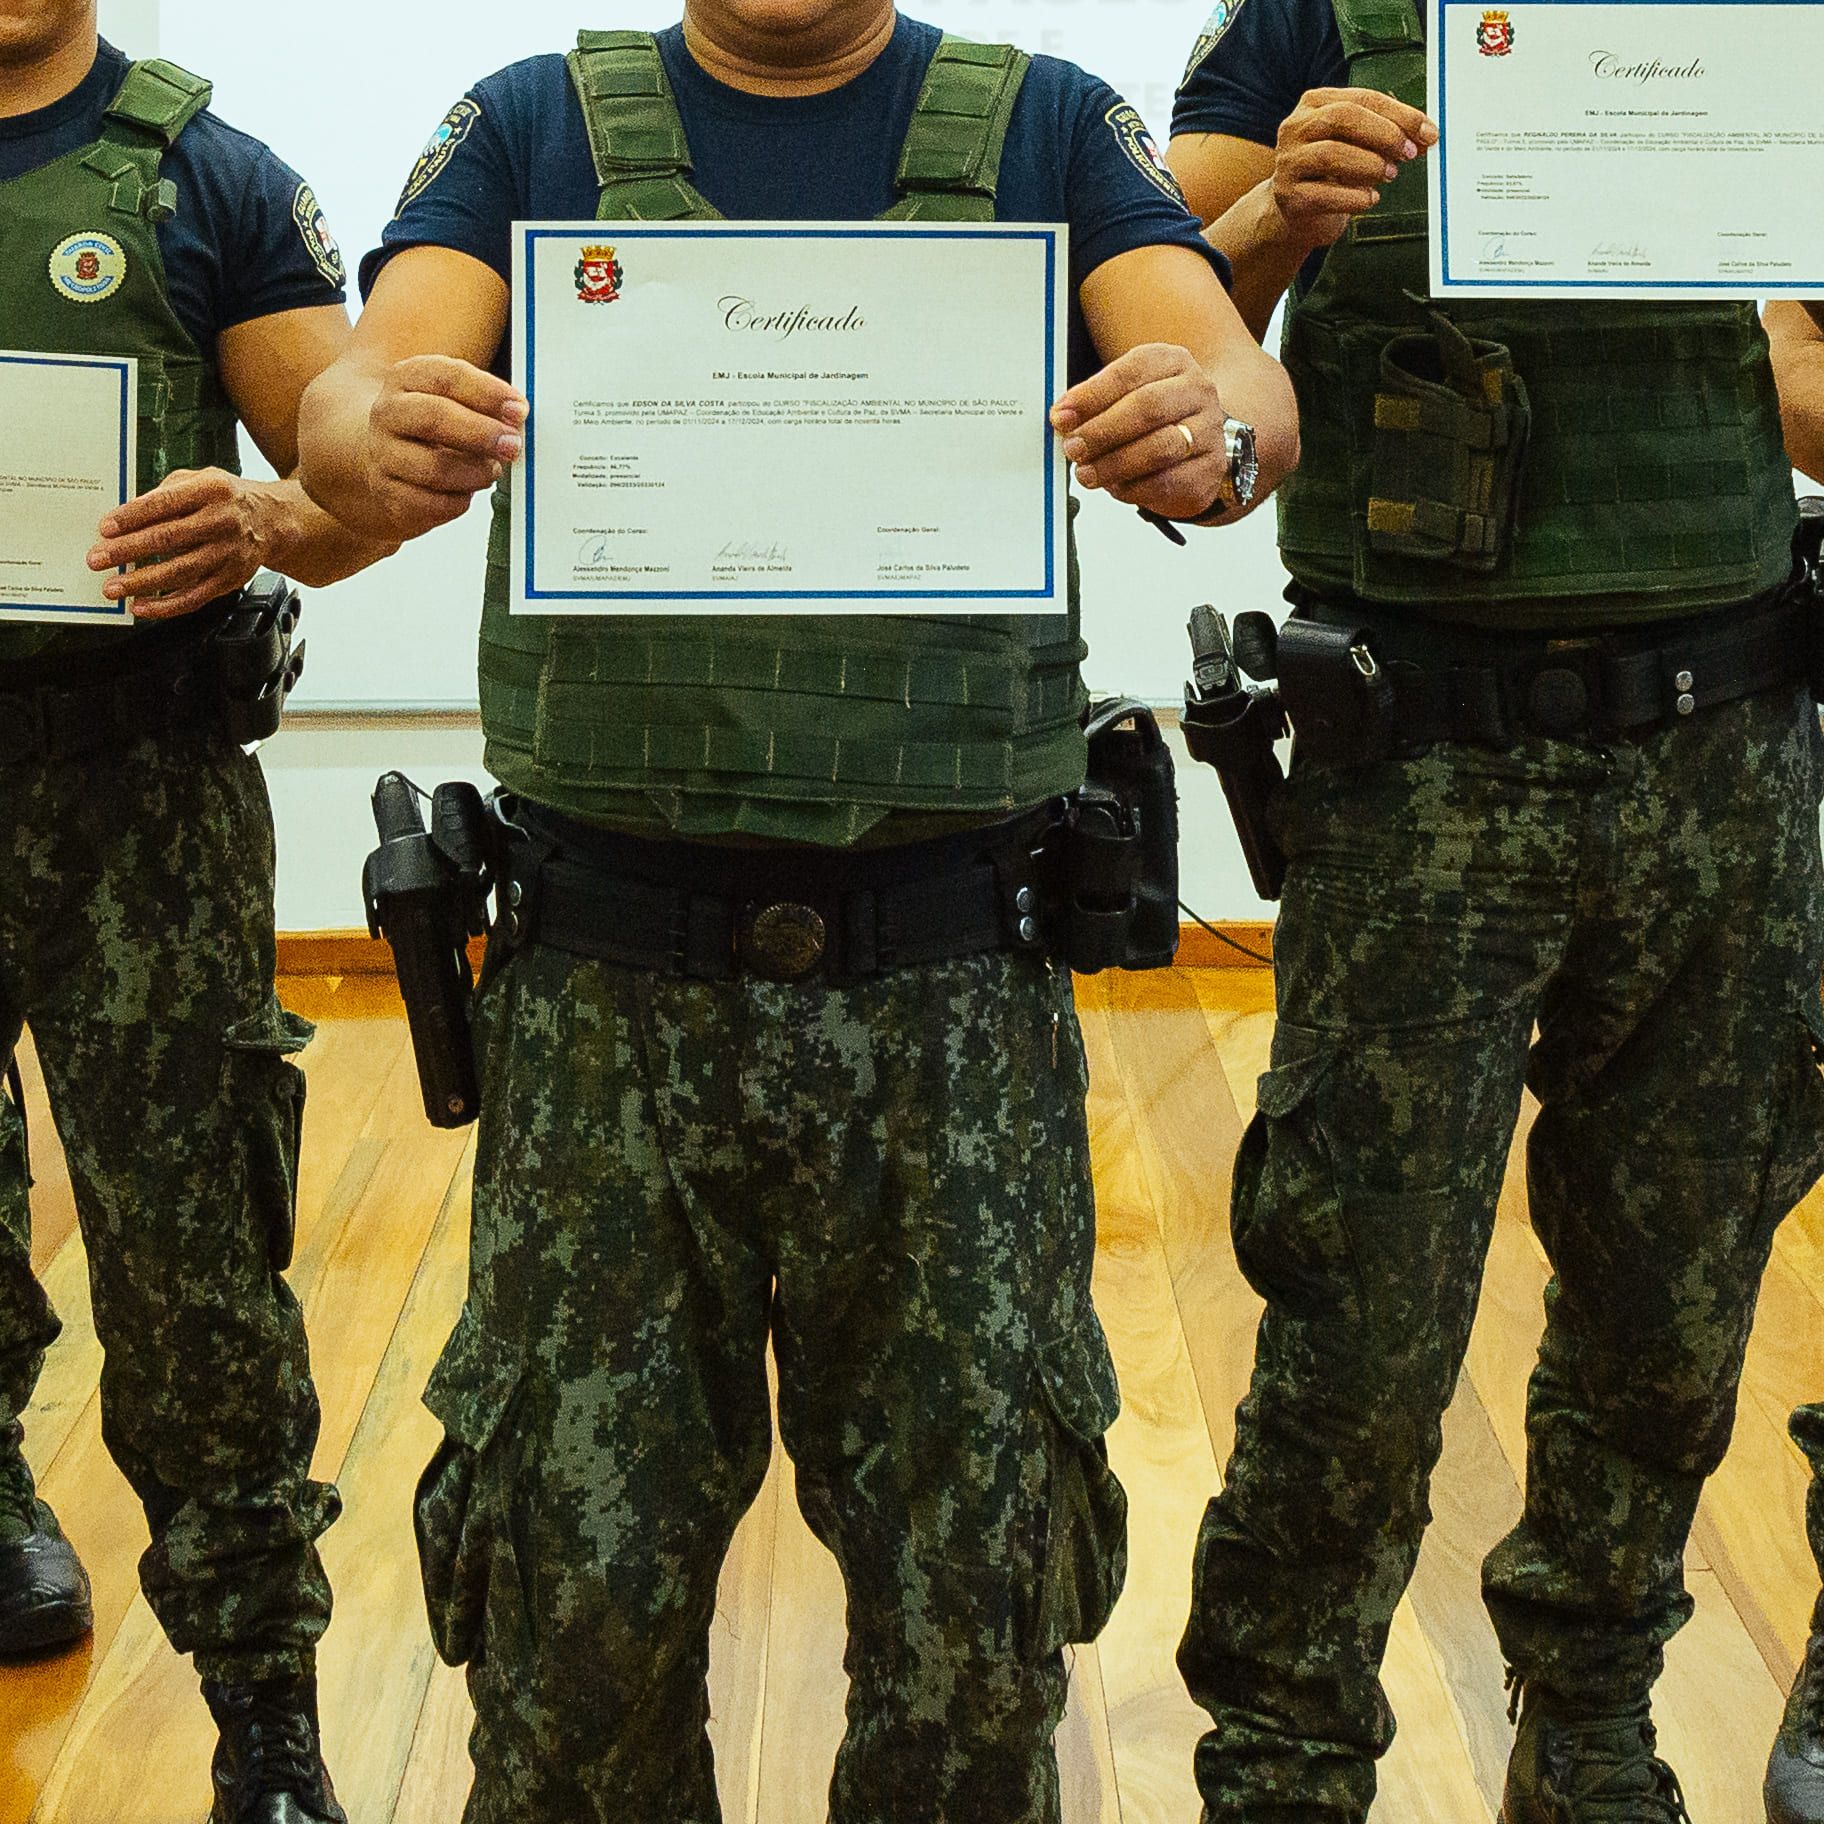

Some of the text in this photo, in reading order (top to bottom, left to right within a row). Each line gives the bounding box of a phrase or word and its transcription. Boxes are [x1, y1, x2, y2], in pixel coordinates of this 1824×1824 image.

[1588, 50, 1706, 87] Certificado
[717, 295, 866, 342] Certificado
[712, 371, 730, 379] EMJ
[737, 371, 765, 379] Escola
[767, 371, 806, 380] Municipal
[808, 371, 819, 379] de
[820, 371, 869, 381] Jardinagem
[632, 399, 658, 407] EDSON
[661, 399, 672, 407] DA
[674, 399, 696, 407] SILVA
[699, 399, 724, 407] COSTA
[860, 399, 901, 407] AMBIENTAL
[904, 399, 916, 407] NO
[959, 399, 968, 407] DE
[972, 398, 988, 407] SÃO
